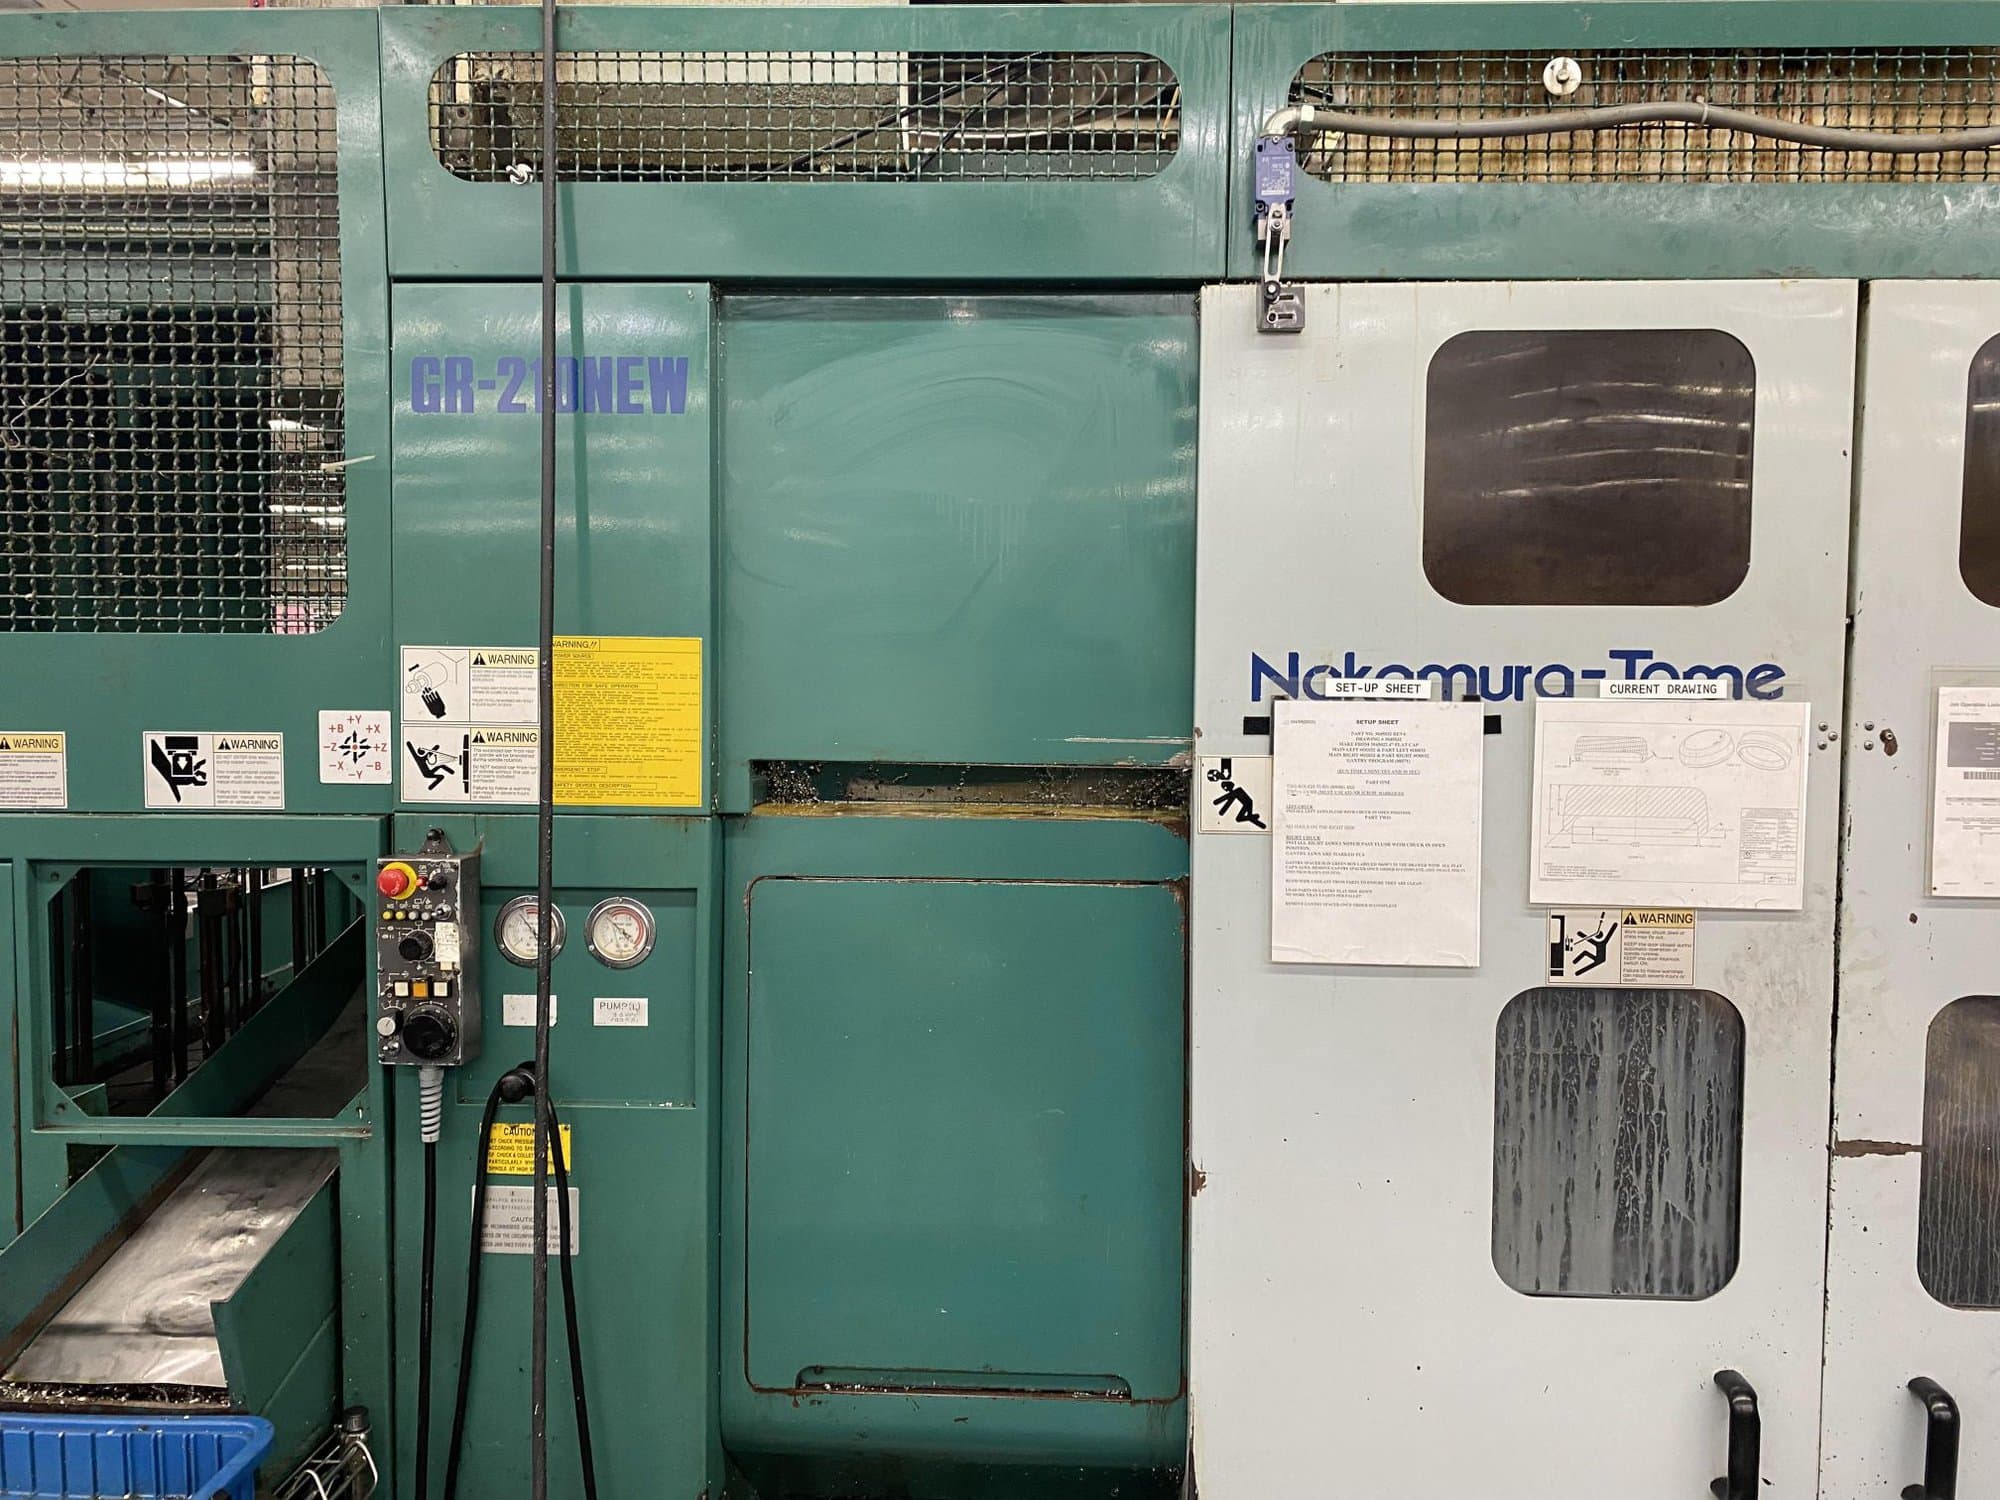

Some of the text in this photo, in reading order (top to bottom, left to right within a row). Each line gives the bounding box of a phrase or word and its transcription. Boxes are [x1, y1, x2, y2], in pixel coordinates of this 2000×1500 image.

[488, 654, 534, 664] WARNING
[1335, 682, 1421, 694] SET-UP SHEET
[1610, 684, 1717, 695] CURRENT DRAWING
[346, 714, 362, 725] +Y
[328, 724, 344, 733] +B
[366, 724, 381, 734] +X
[487, 732, 537, 742] WARNING
[13, 738, 59, 749] WARNING
[231, 740, 279, 750] WARNING
[323, 743, 337, 752] -Z
[374, 743, 388, 752] +Z
[329, 761, 344, 771] -X
[366, 762, 382, 771] -B
[348, 770, 363, 780] -Y
[1640, 913, 1693, 924] WARNING
